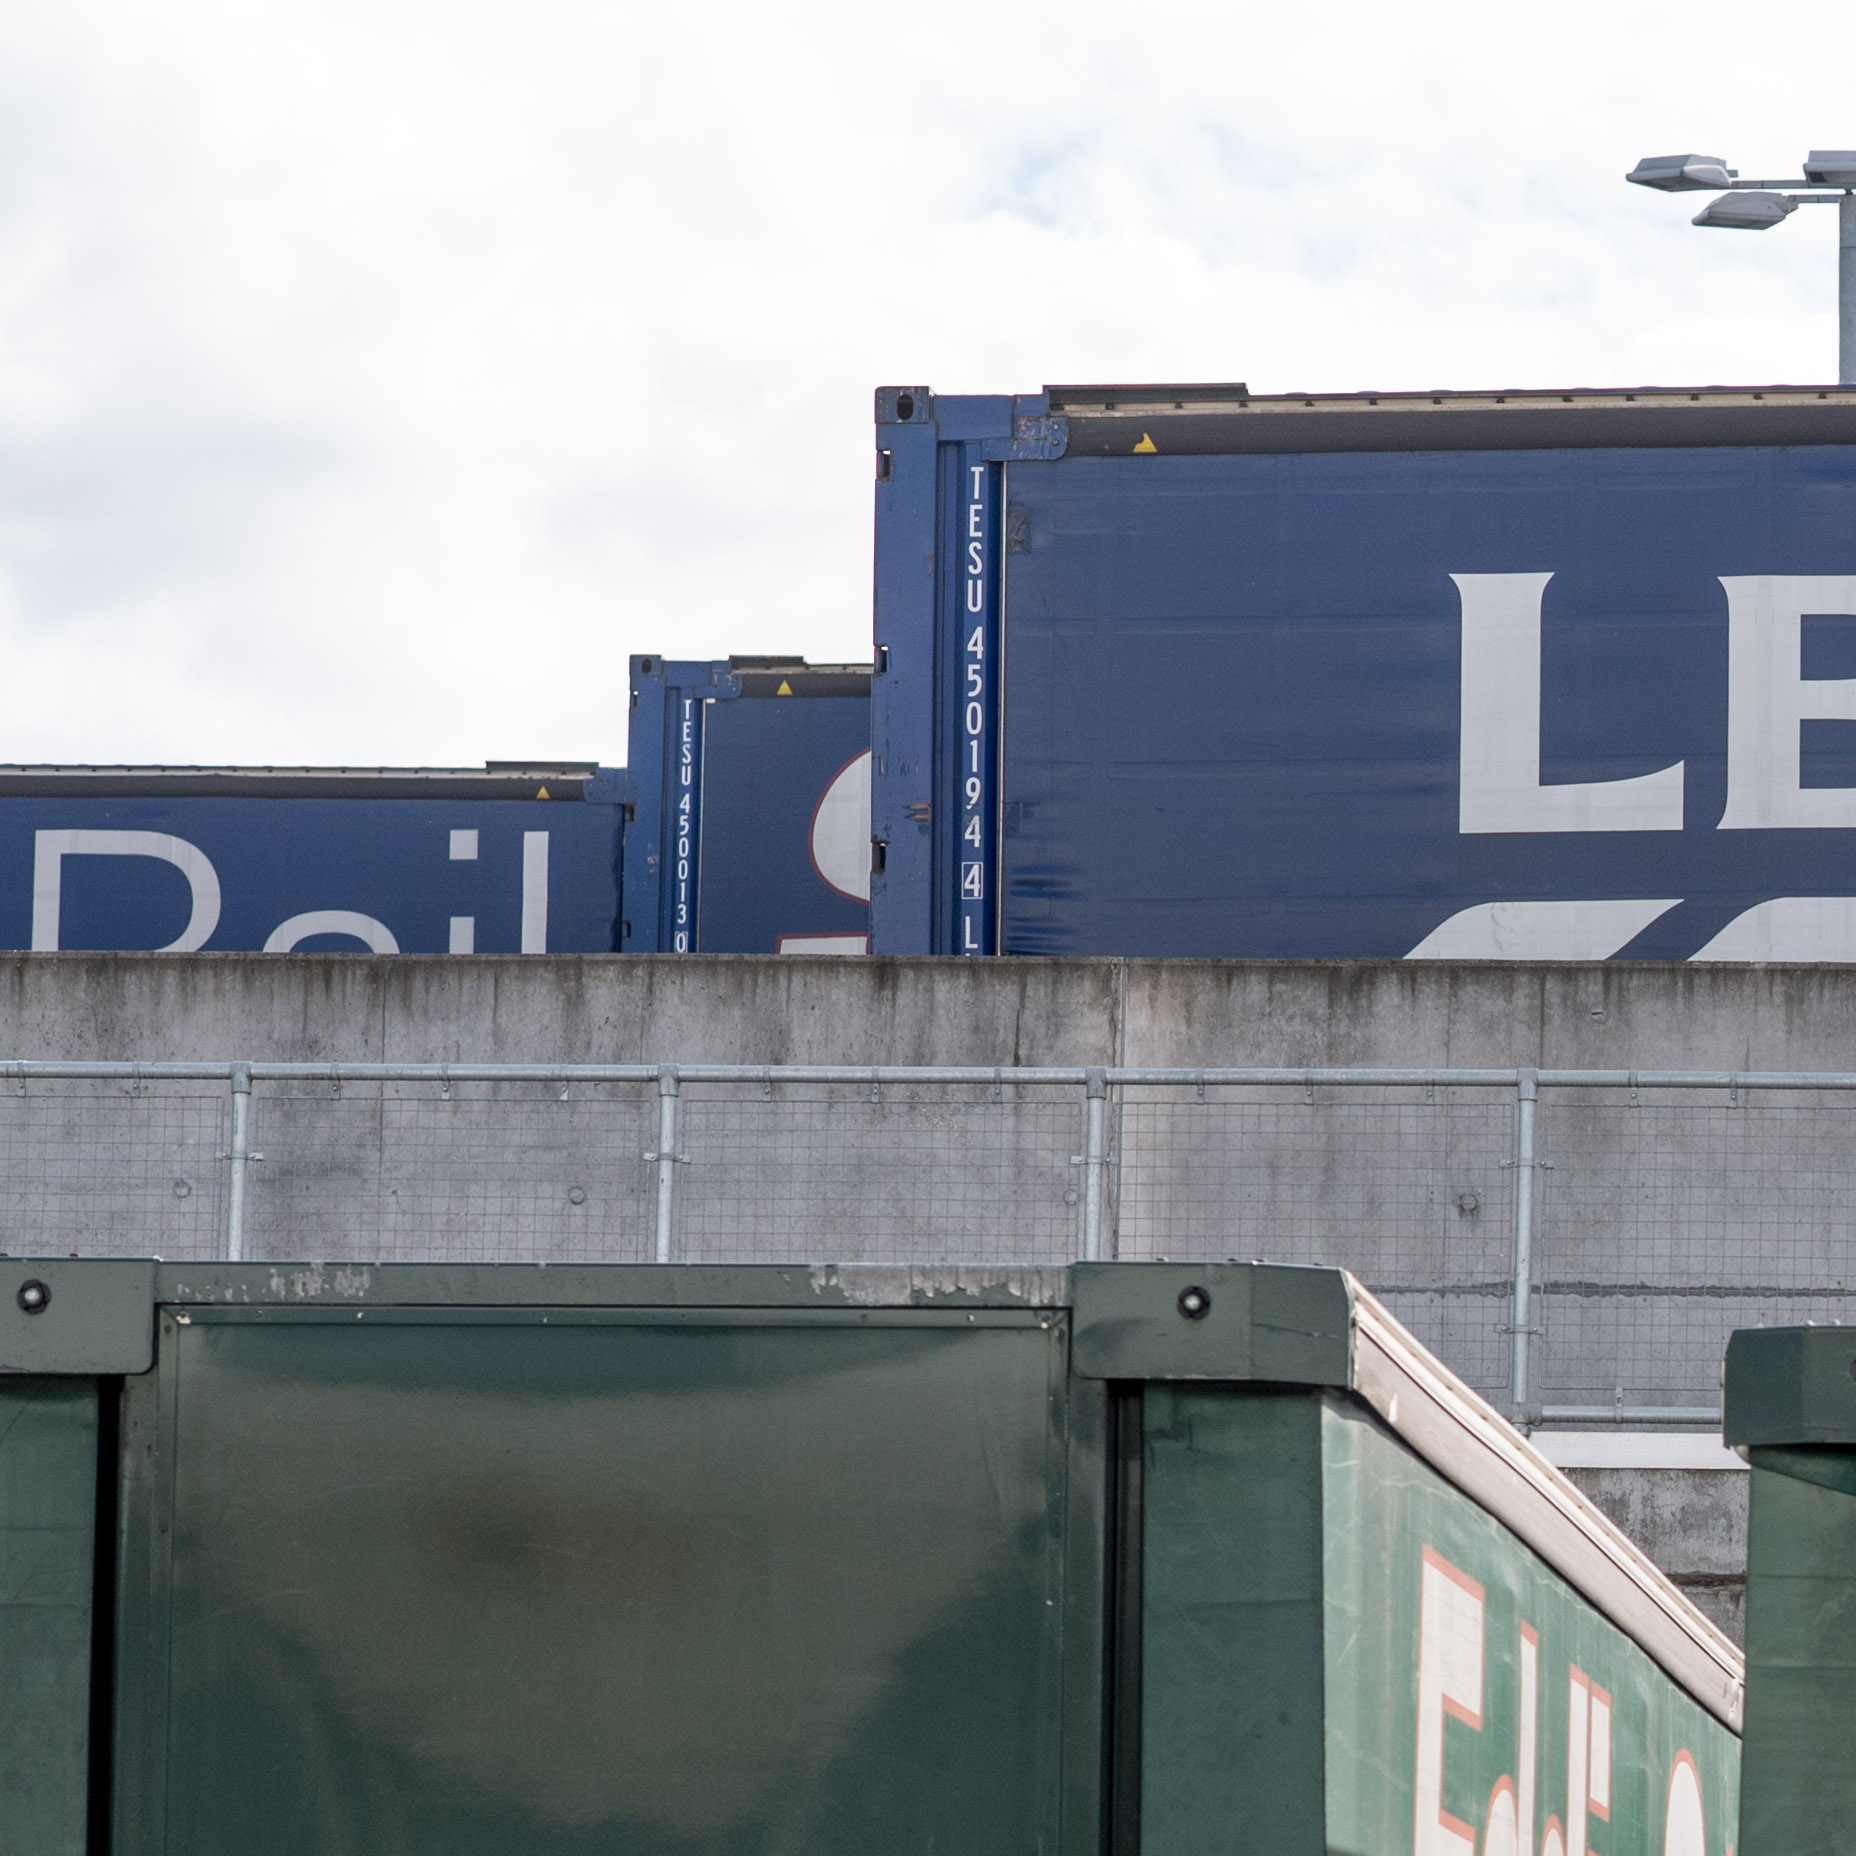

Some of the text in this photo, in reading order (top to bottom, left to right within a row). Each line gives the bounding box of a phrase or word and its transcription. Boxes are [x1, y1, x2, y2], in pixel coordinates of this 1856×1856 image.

[681, 699, 693, 786] TESU
[963, 465, 985, 957] TESU 450194 4 L
[676, 792, 691, 925] 450013
